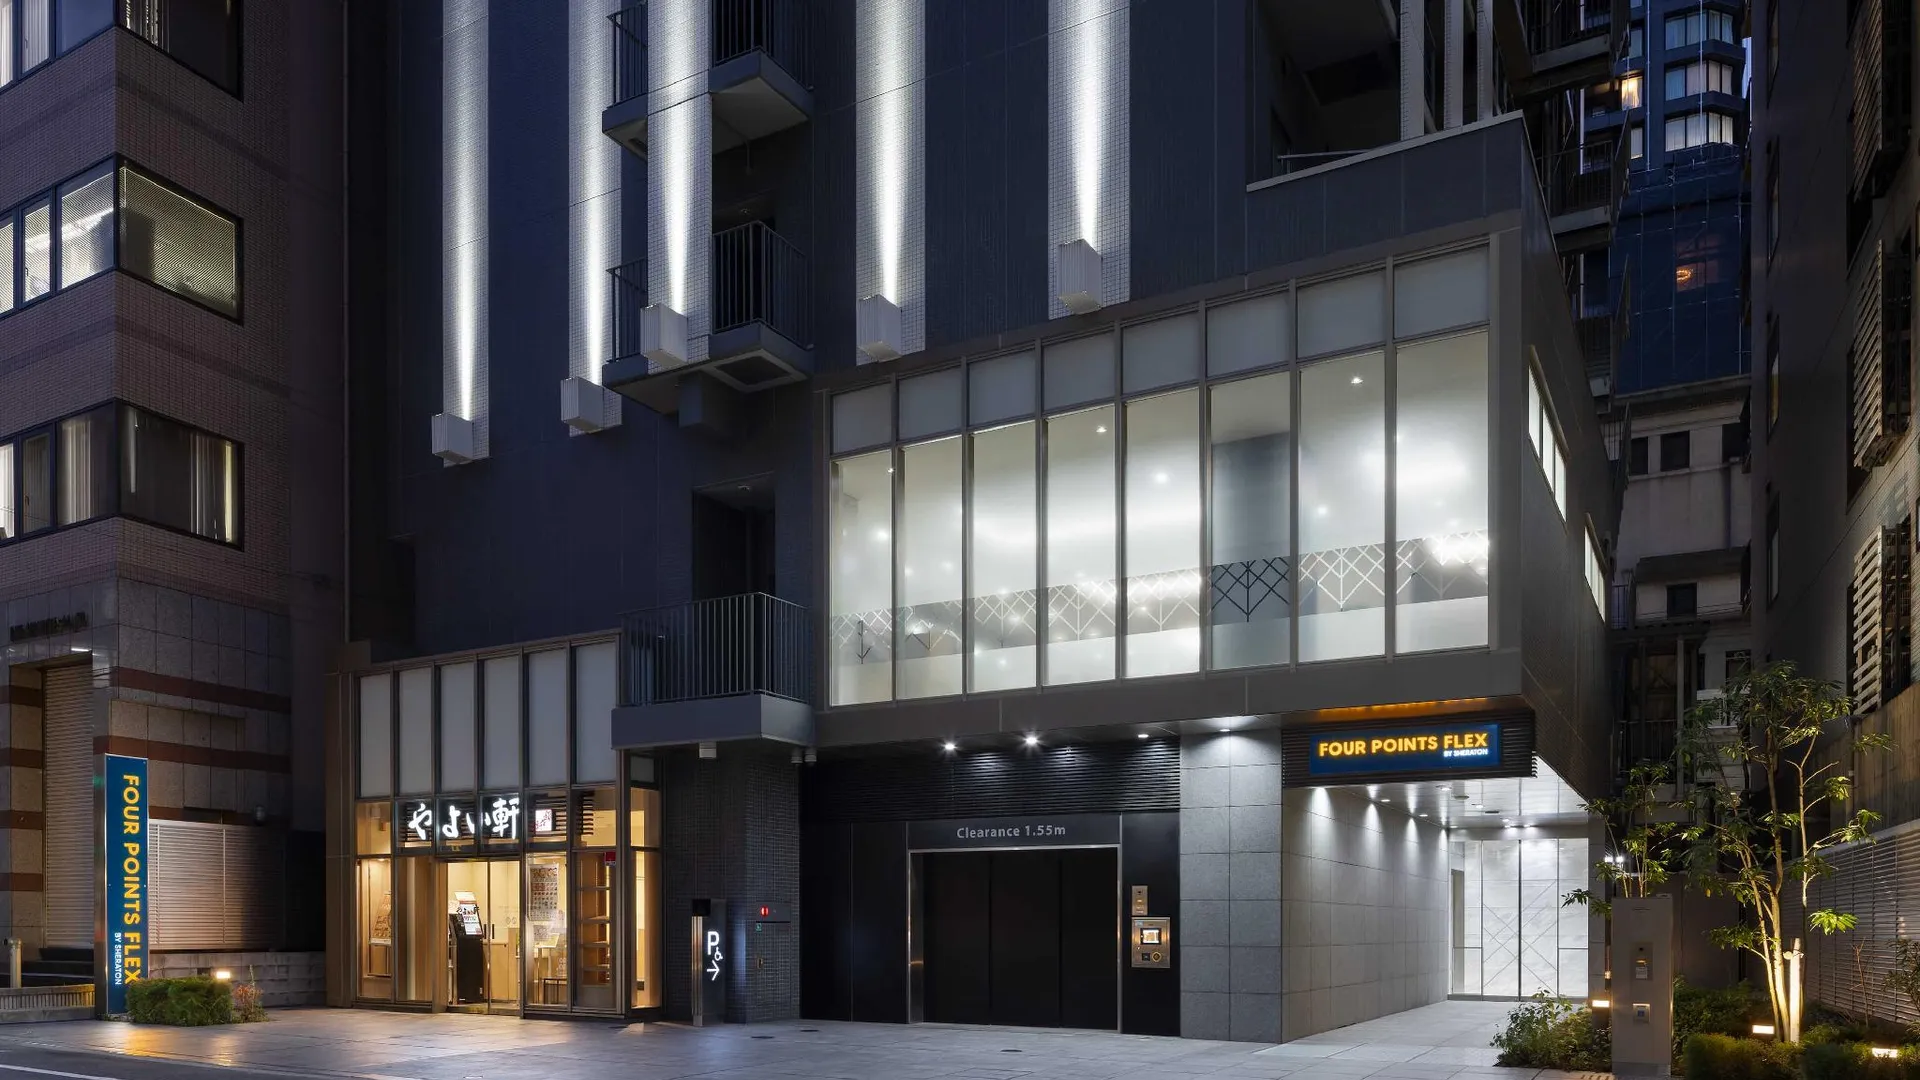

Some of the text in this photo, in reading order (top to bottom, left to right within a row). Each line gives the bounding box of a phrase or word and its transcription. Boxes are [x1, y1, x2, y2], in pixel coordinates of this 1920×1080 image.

[1319, 733, 1488, 757] FOUR POINTS FLEX
[1453, 749, 1488, 757] SHERATON
[408, 797, 520, 840] やよい軒
[956, 825, 1066, 838] Clearance 1.55m
[123, 774, 142, 985] FOUR POINTS FLEX
[707, 931, 720, 955] P
[114, 932, 122, 985] BY SHERATON
